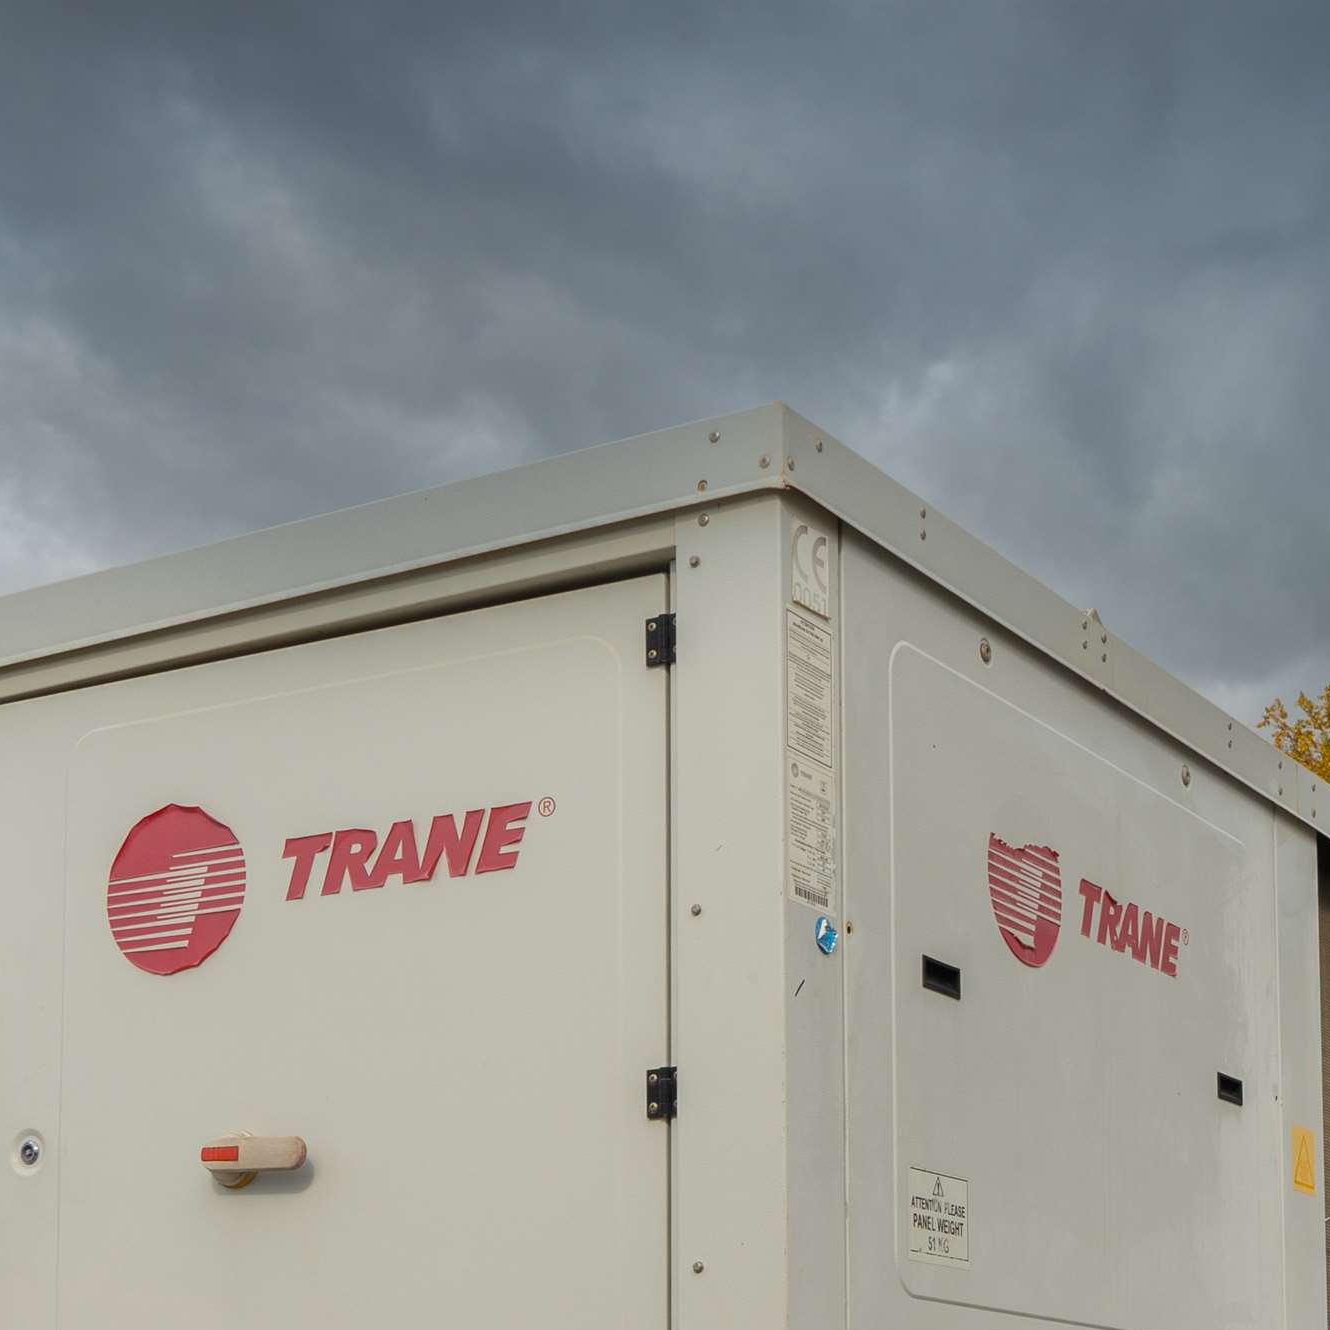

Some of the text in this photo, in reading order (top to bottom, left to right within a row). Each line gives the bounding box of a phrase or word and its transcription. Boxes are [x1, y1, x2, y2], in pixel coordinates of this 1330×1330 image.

[282, 801, 533, 901] TRANE
[1078, 877, 1181, 978] TRANE
[910, 1195, 966, 1218] ATTENTION PLEASE
[912, 1213, 964, 1237] PANEL WEIGHT
